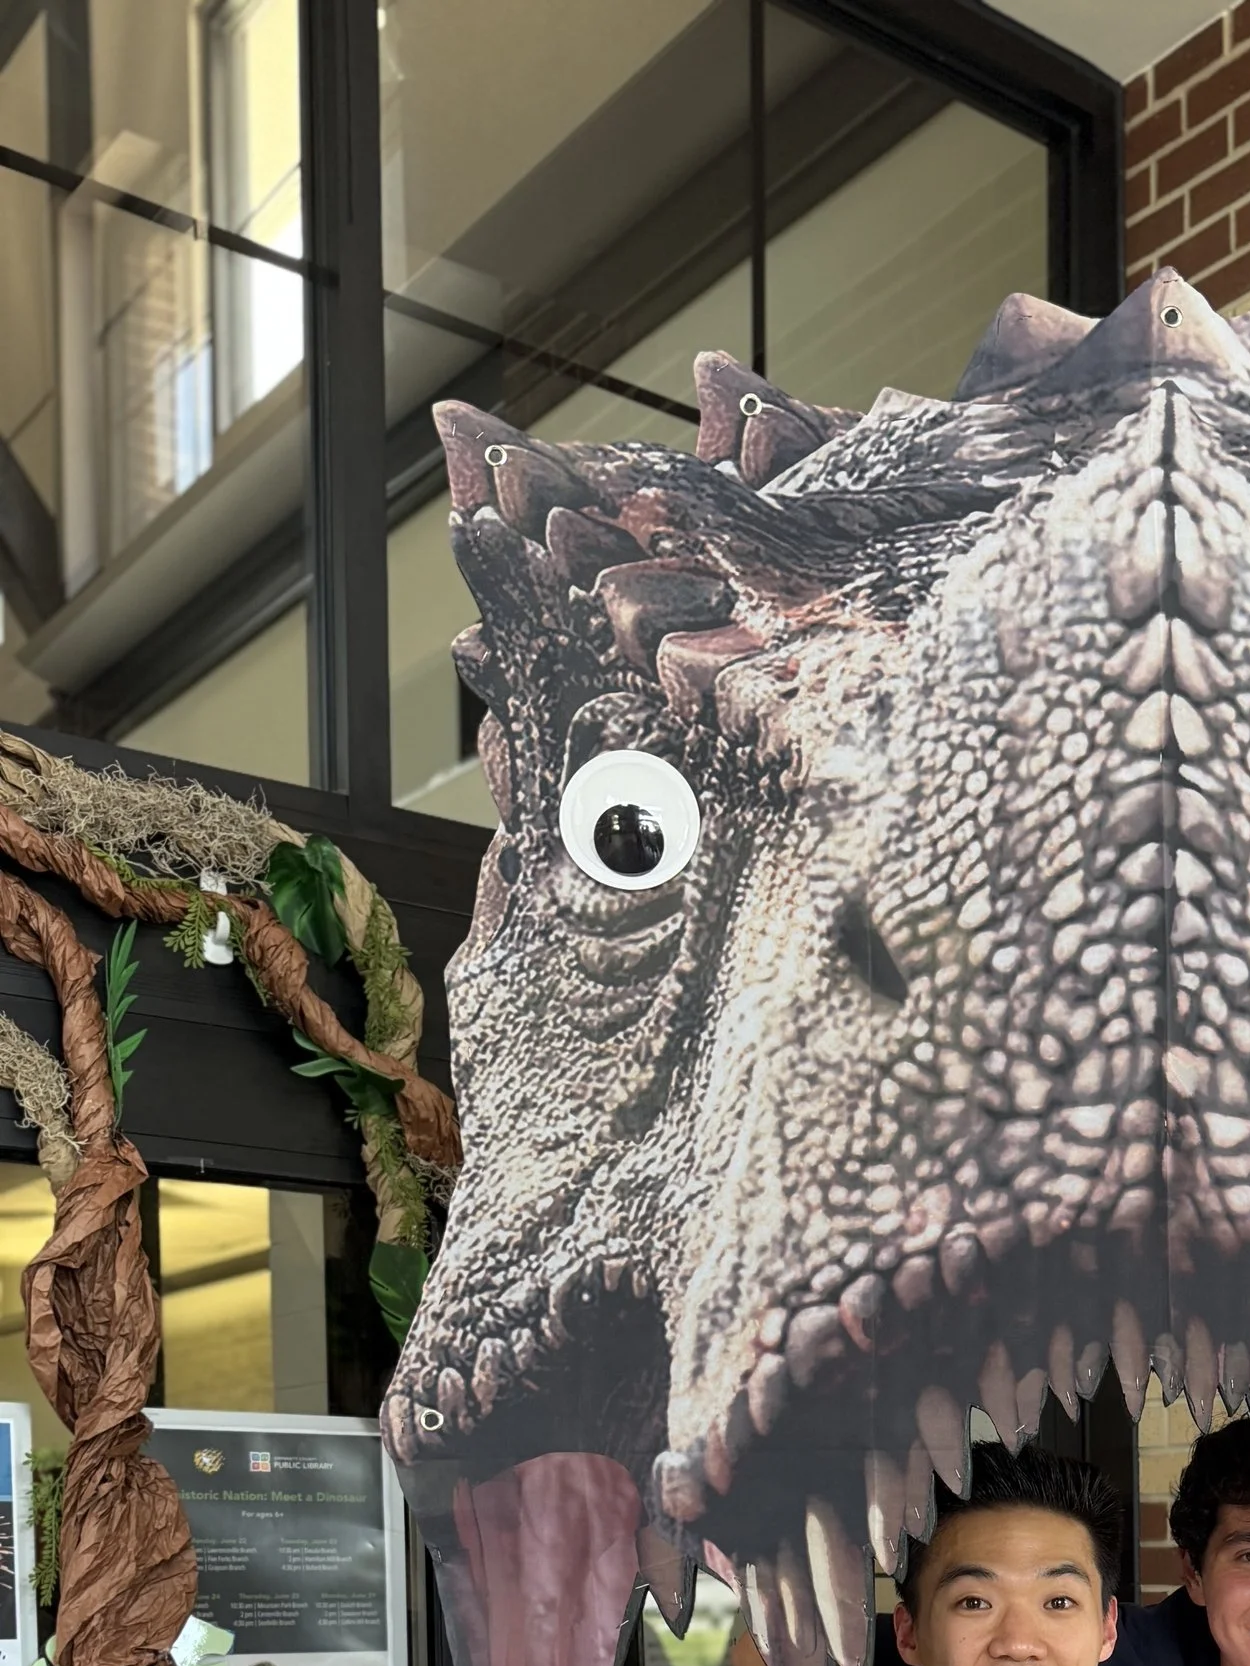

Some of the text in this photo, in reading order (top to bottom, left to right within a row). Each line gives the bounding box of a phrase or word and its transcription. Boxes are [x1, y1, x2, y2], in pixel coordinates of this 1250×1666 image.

[273, 1461, 334, 1471] PUBLIC LIBRARY
[179, 1489, 367, 1504] istoric Nation: Meet a Dinosaur
[241, 1510, 285, 1520] For ages 6+
